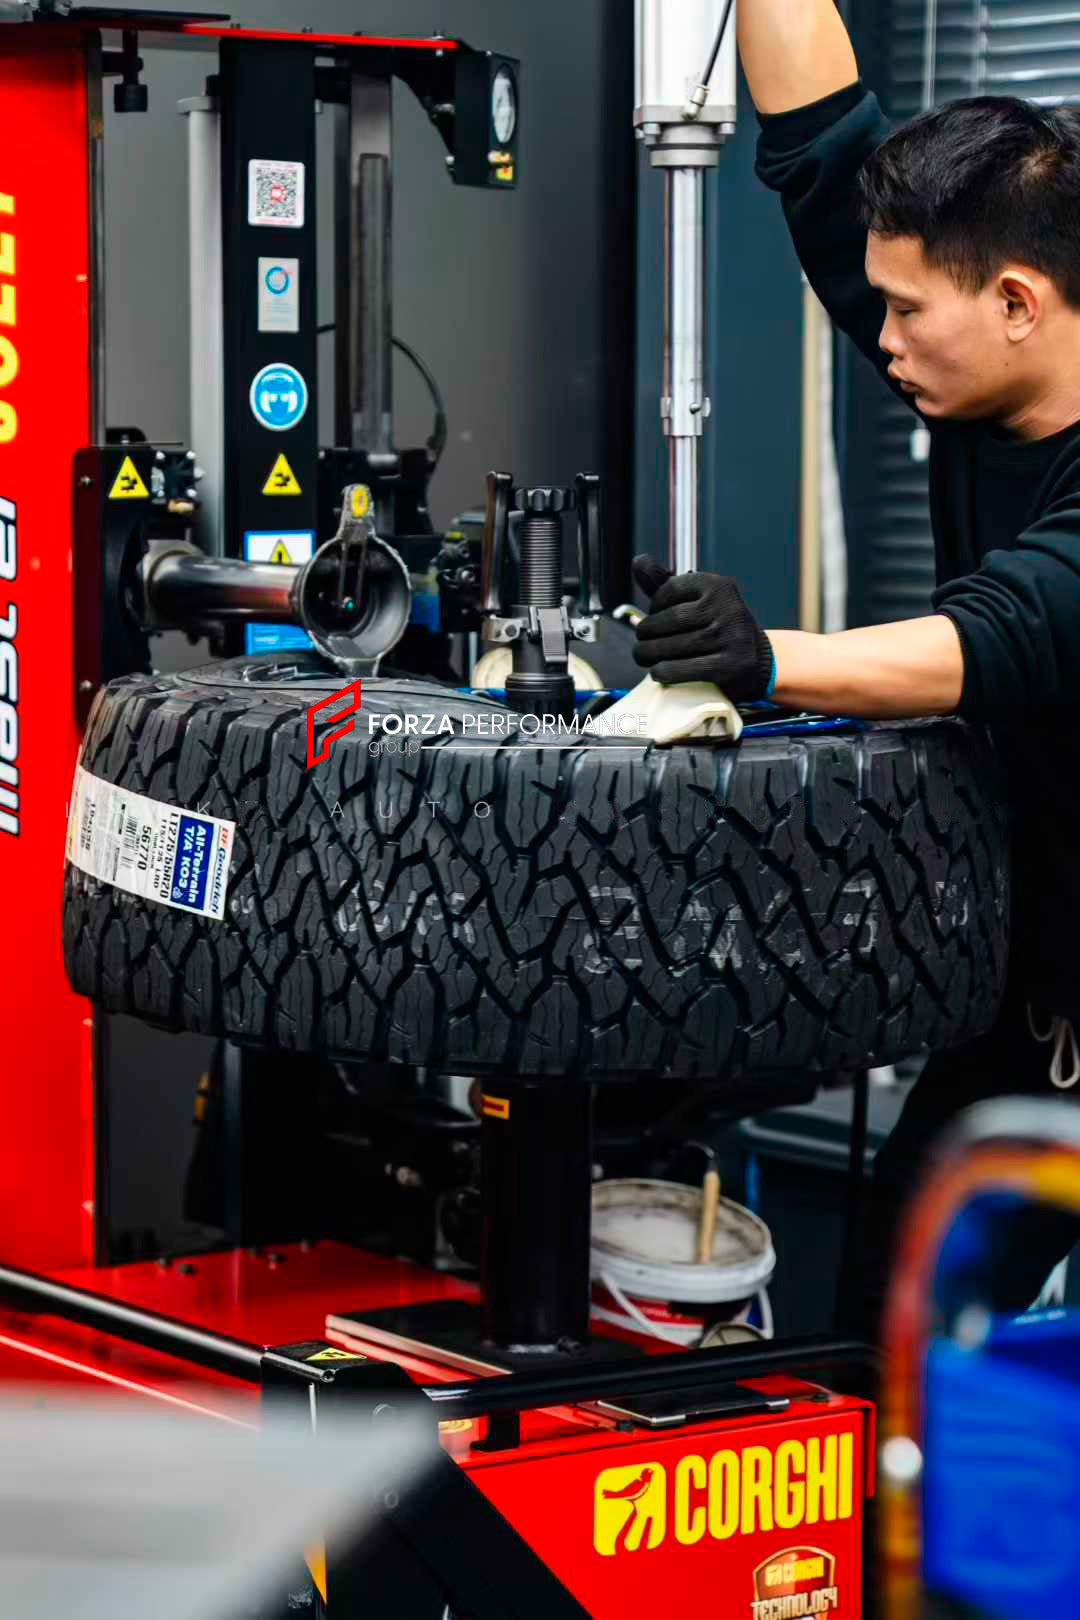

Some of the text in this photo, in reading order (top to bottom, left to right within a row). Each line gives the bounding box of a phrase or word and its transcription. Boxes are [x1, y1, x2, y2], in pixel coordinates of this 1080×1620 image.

[137, 825, 152, 871] 56770
[160, 812, 179, 899] LT275/55R20
[178, 856, 191, 889] KO3
[188, 825, 206, 903] All-Terrain
[675, 1432, 854, 1546] CORGHI
